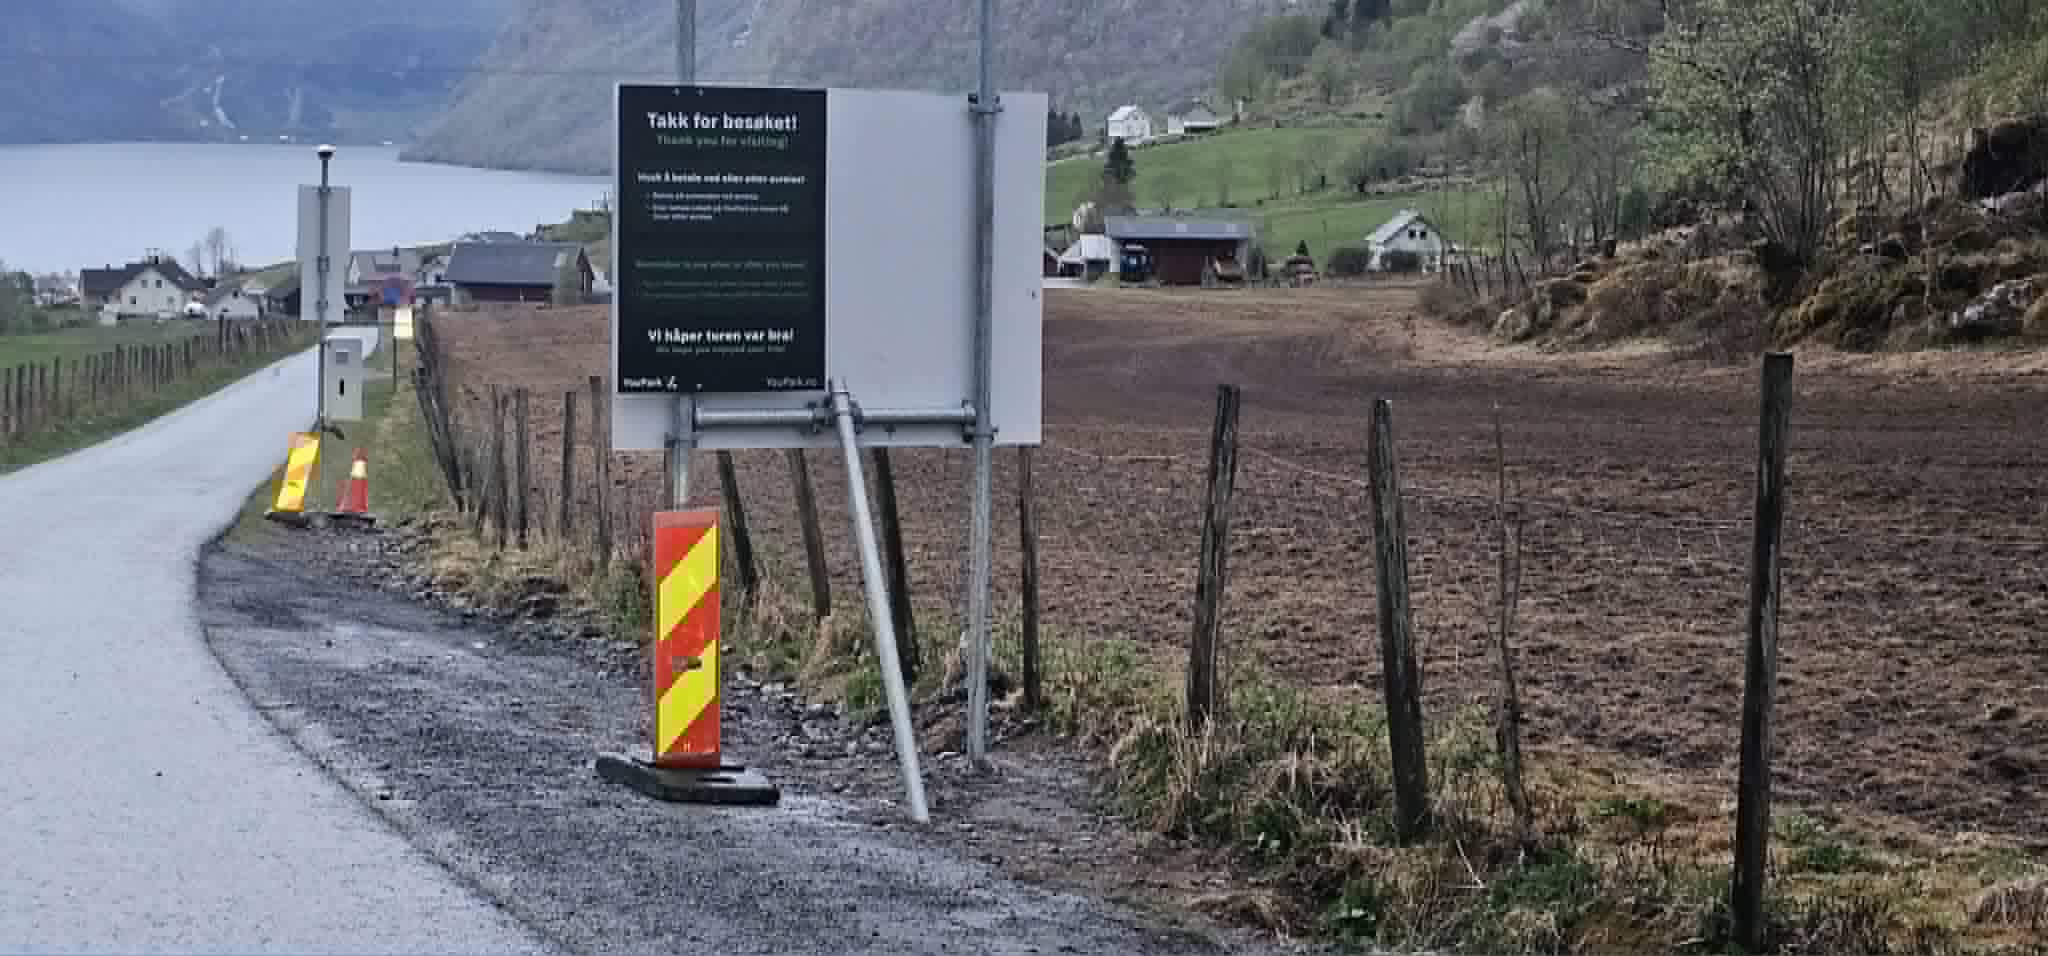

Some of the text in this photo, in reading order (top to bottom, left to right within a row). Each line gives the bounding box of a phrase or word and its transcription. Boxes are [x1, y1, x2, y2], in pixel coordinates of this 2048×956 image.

[647, 111, 798, 131] Takk for besøket!
[656, 134, 790, 150] Thank you for visiting!
[648, 328, 794, 344] Vi håper turen var bra!
